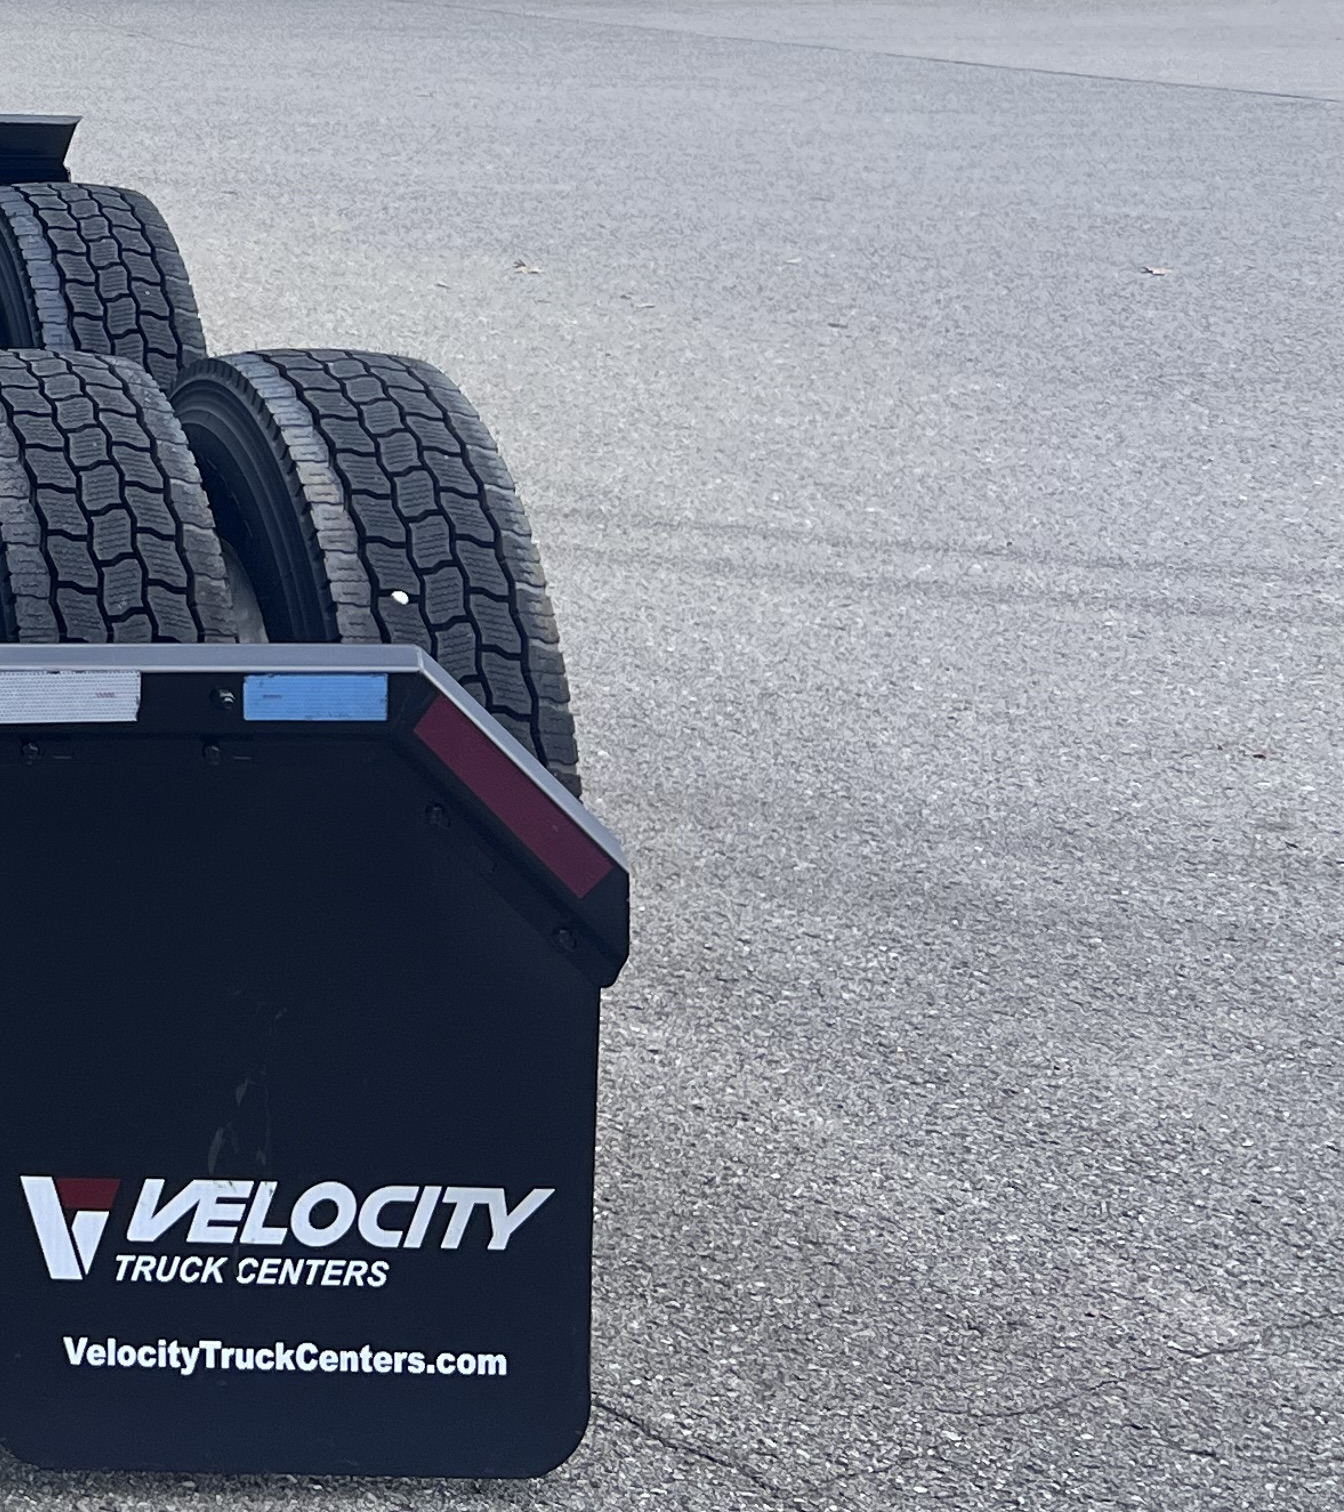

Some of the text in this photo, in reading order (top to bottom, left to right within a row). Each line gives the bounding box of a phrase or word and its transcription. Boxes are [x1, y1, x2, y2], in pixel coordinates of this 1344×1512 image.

[125, 1177, 557, 1251] VELOCITY
[114, 1254, 390, 1287] TRUCK CENTERS
[63, 1336, 507, 1376] VelocityTruckCenters.com
